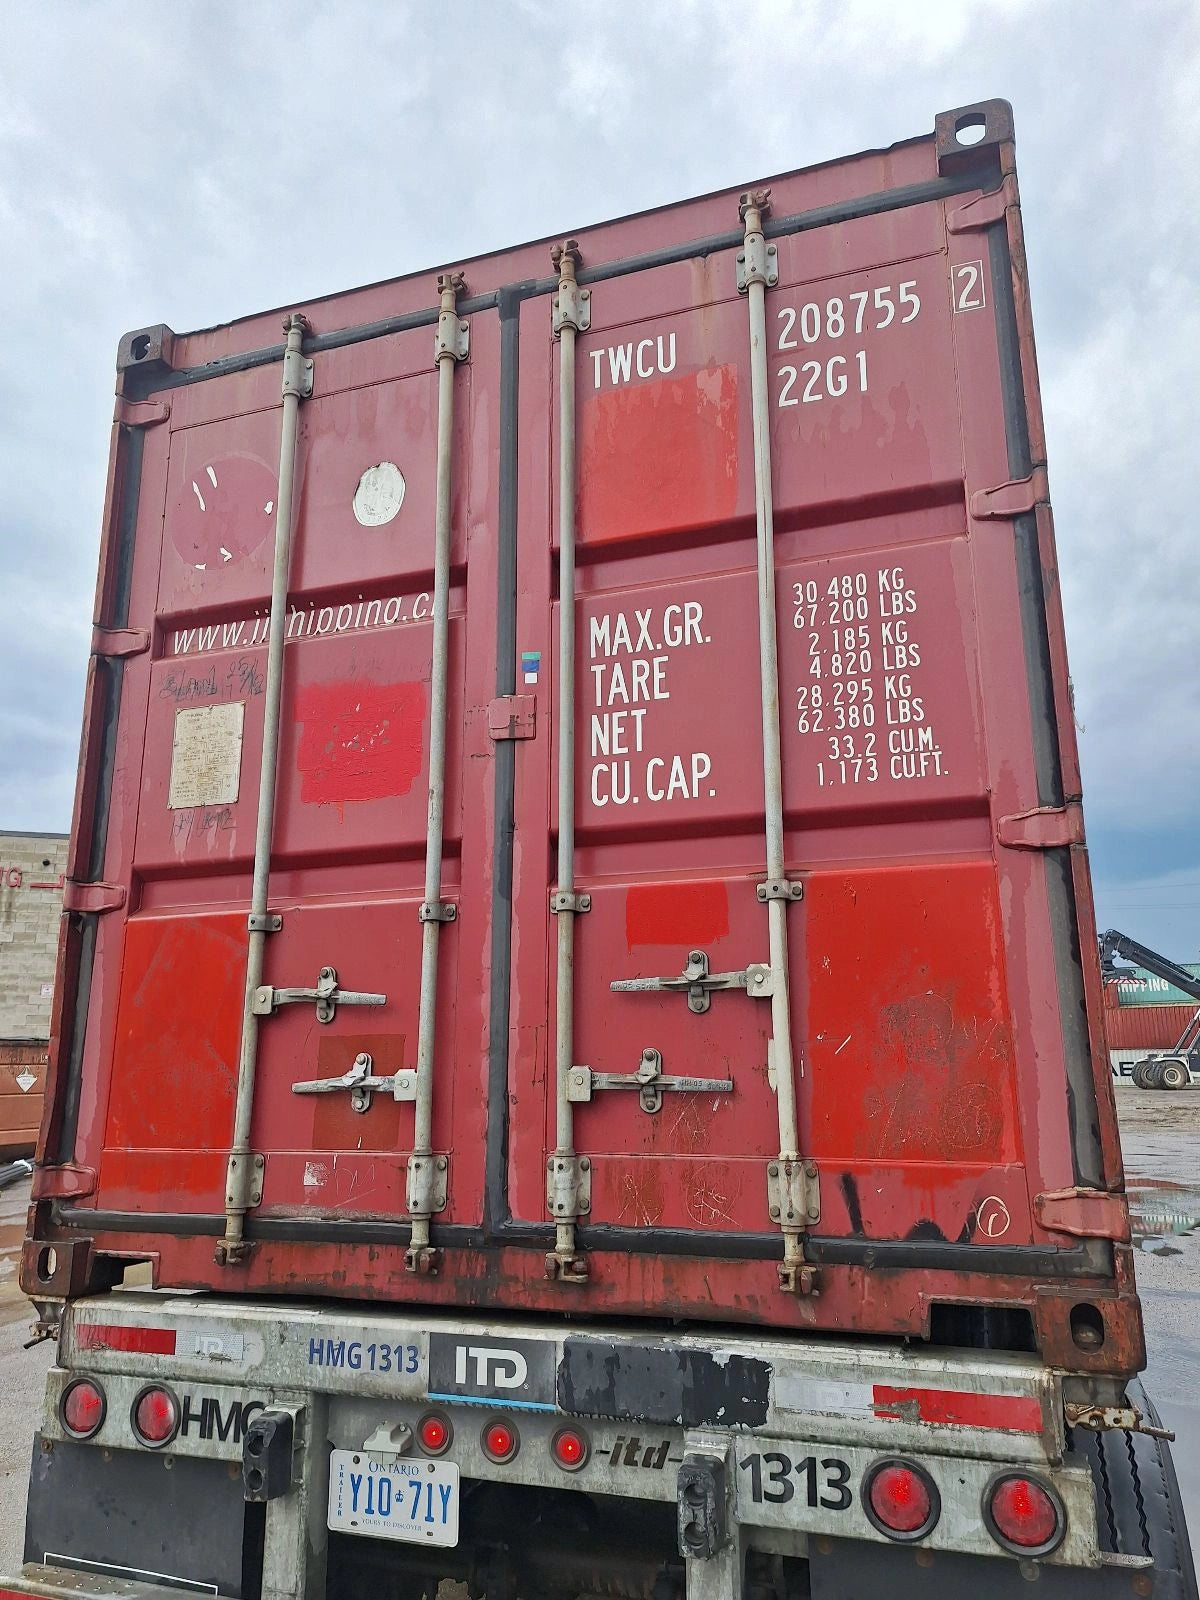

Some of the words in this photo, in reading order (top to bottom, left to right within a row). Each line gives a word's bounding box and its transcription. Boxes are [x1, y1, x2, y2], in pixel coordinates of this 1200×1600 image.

[589, 332, 677, 389] TWCU
[777, 279, 921, 350] 208755
[957, 264, 981, 310] 2
[777, 349, 868, 408] 22G1
[792, 572, 867, 606] 30,480
[877, 567, 904, 593] KG
[793, 596, 869, 629] 67,200
[879, 589, 917, 617] LBS
[589, 601, 712, 659] MAX.GR.
[808, 625, 870, 656] 2,185
[881, 619, 908, 646] KG
[809, 649, 872, 679] 4,820
[882, 643, 921, 671] LBS
[590, 656, 671, 707] TARE
[796, 678, 874, 710] 28,295
[884, 673, 912, 700] KG
[591, 708, 647, 757] NET
[798, 703, 875, 734] 62,380
[886, 697, 925, 725] LBS
[828, 732, 877, 760] 33.2
[888, 726, 940, 754] CU.M.
[816, 758, 879, 787] 1,173
[890, 750, 949, 780] CU.FT.
[0, 866, 22, 888] G
[368, 1460, 420, 1477] ONTARIO
[739, 1452, 853, 1511] 1313
[337, 1463, 345, 1517] TRAILER
[392, 1523, 422, 1532] DISCOVER
